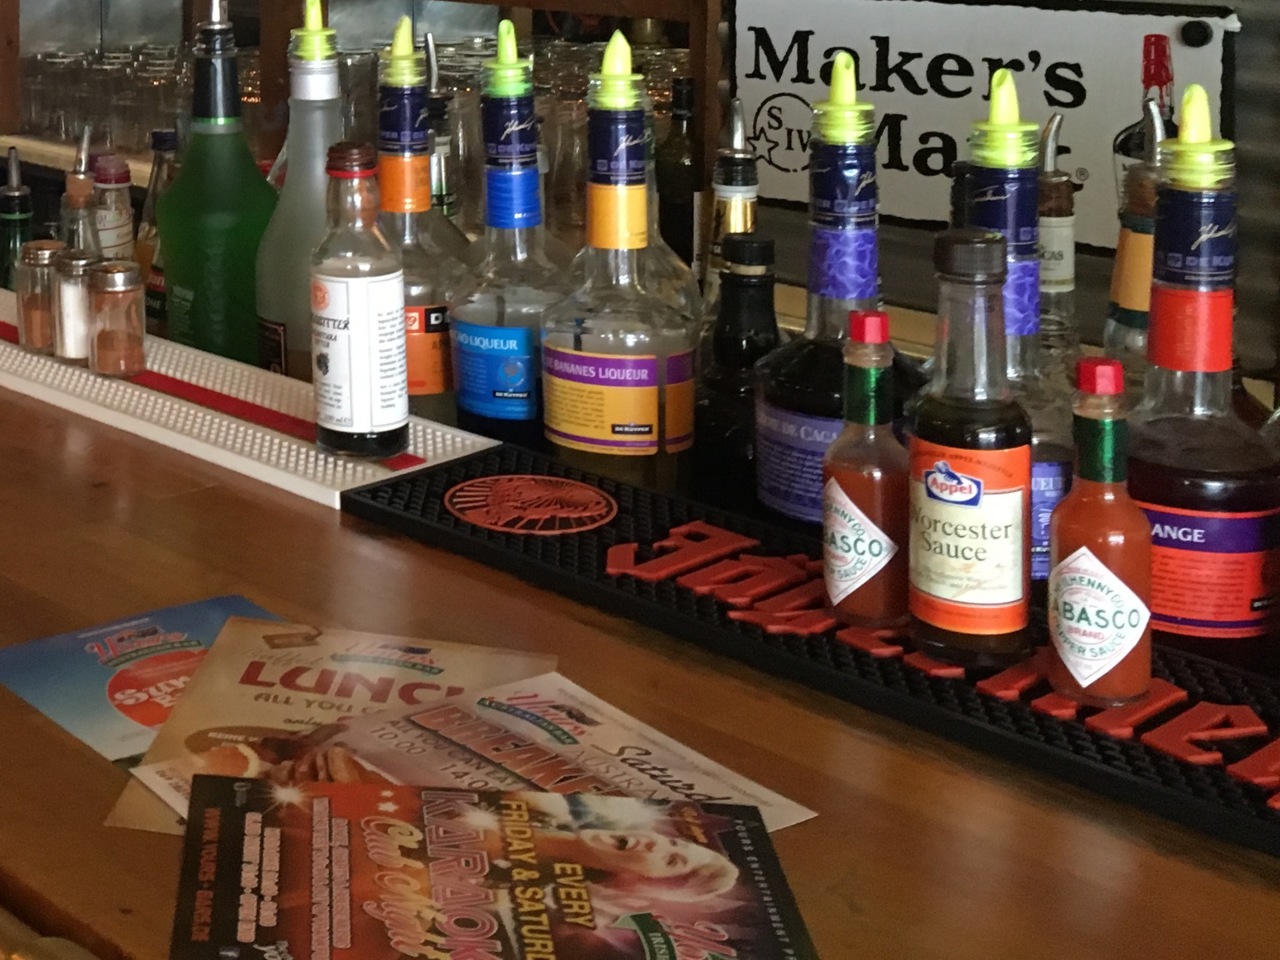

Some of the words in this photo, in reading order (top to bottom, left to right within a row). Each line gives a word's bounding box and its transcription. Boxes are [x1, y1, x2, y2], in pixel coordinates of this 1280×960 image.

[745, 26, 1087, 108] Maker's
[767, 106, 783, 130] S
[469, 336, 519, 351] LIQUEUR
[554, 358, 596, 378] BANANES
[598, 367, 650, 381] LIQUEUR
[930, 476, 973, 496] Appel
[1151, 523, 1206, 543] ANGE
[921, 531, 988, 562] Sauce
[1065, 624, 1105, 641] BRAND
[253, 691, 297, 706] ALL
[304, 697, 355, 714] YOU
[440, 763, 497, 791] 14.0
[500, 800, 537, 865] FRIDAY
[511, 868, 541, 882] &
[734, 819, 755, 852] YOURS
[747, 855, 792, 944] ENTERTAINMENT
[553, 862, 597, 930] EVERY
